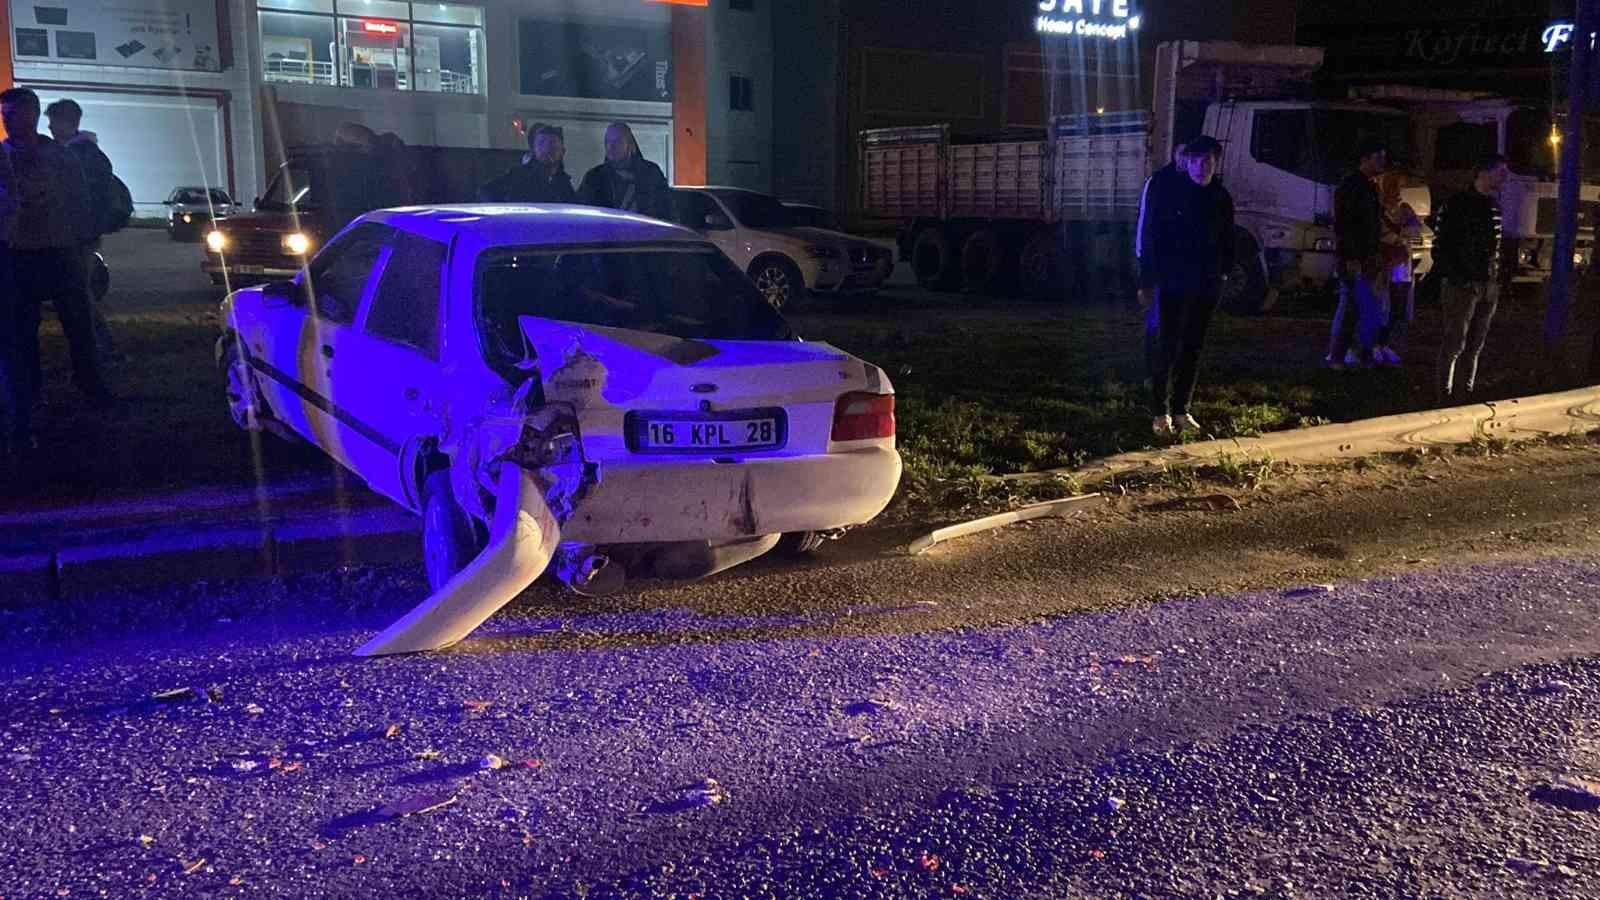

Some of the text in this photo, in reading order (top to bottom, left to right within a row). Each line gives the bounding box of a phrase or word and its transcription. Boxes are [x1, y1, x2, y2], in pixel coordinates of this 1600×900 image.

[1037, 16, 1126, 39] Home Concept
[650, 421, 771, 445] 16 KPL 28
